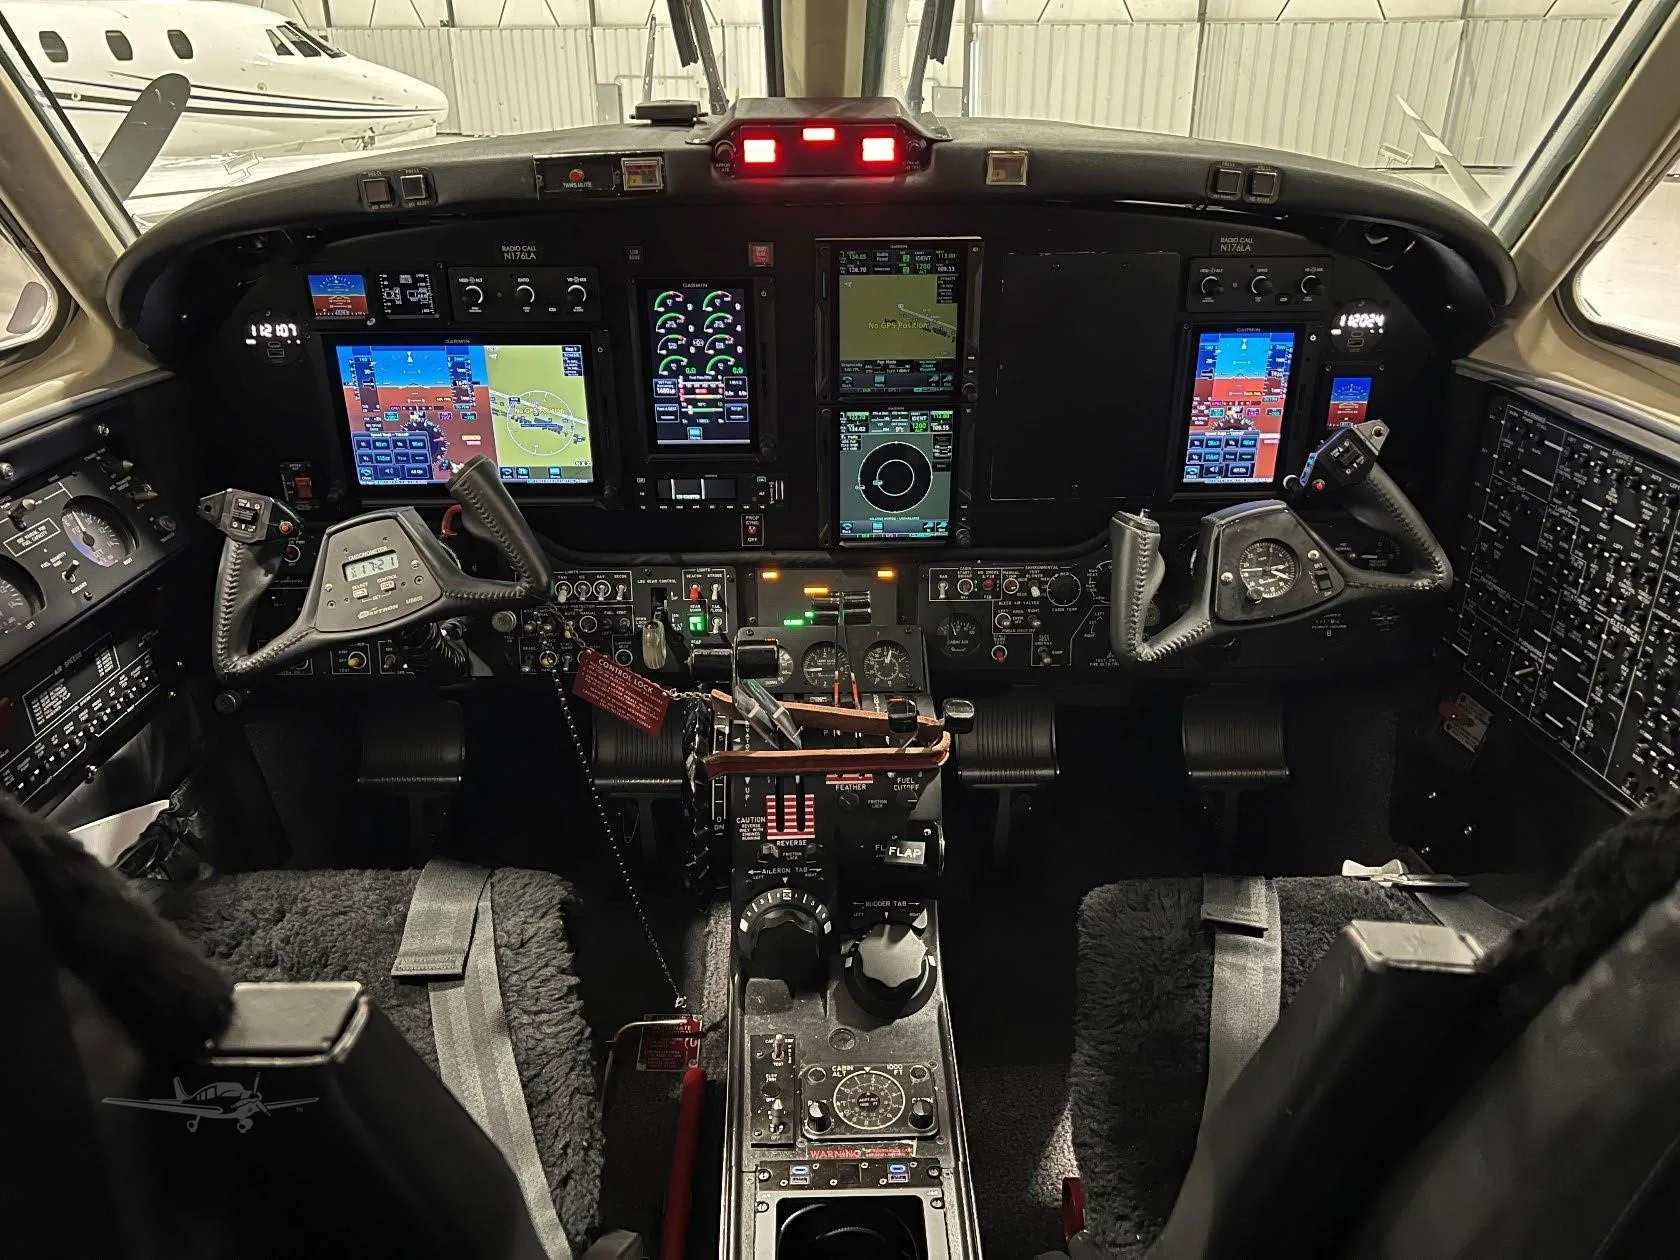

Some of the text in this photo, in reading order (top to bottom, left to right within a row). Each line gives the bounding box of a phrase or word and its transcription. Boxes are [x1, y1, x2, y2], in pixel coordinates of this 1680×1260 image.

[1220, 244, 1252, 252] N176LA
[504, 252, 537, 260] N176LA
[868, 321, 929, 329] No GPS Position
[376, 574, 398, 583] CONTROL
[352, 582, 369, 591] SELECT
[1610, 618, 1643, 642] ELECTRICAL
[598, 659, 654, 694] CONTROL LOCK
[736, 816, 766, 824] CAUTION
[888, 846, 921, 858] FLAP
[810, 1149, 862, 1158] WARNING
